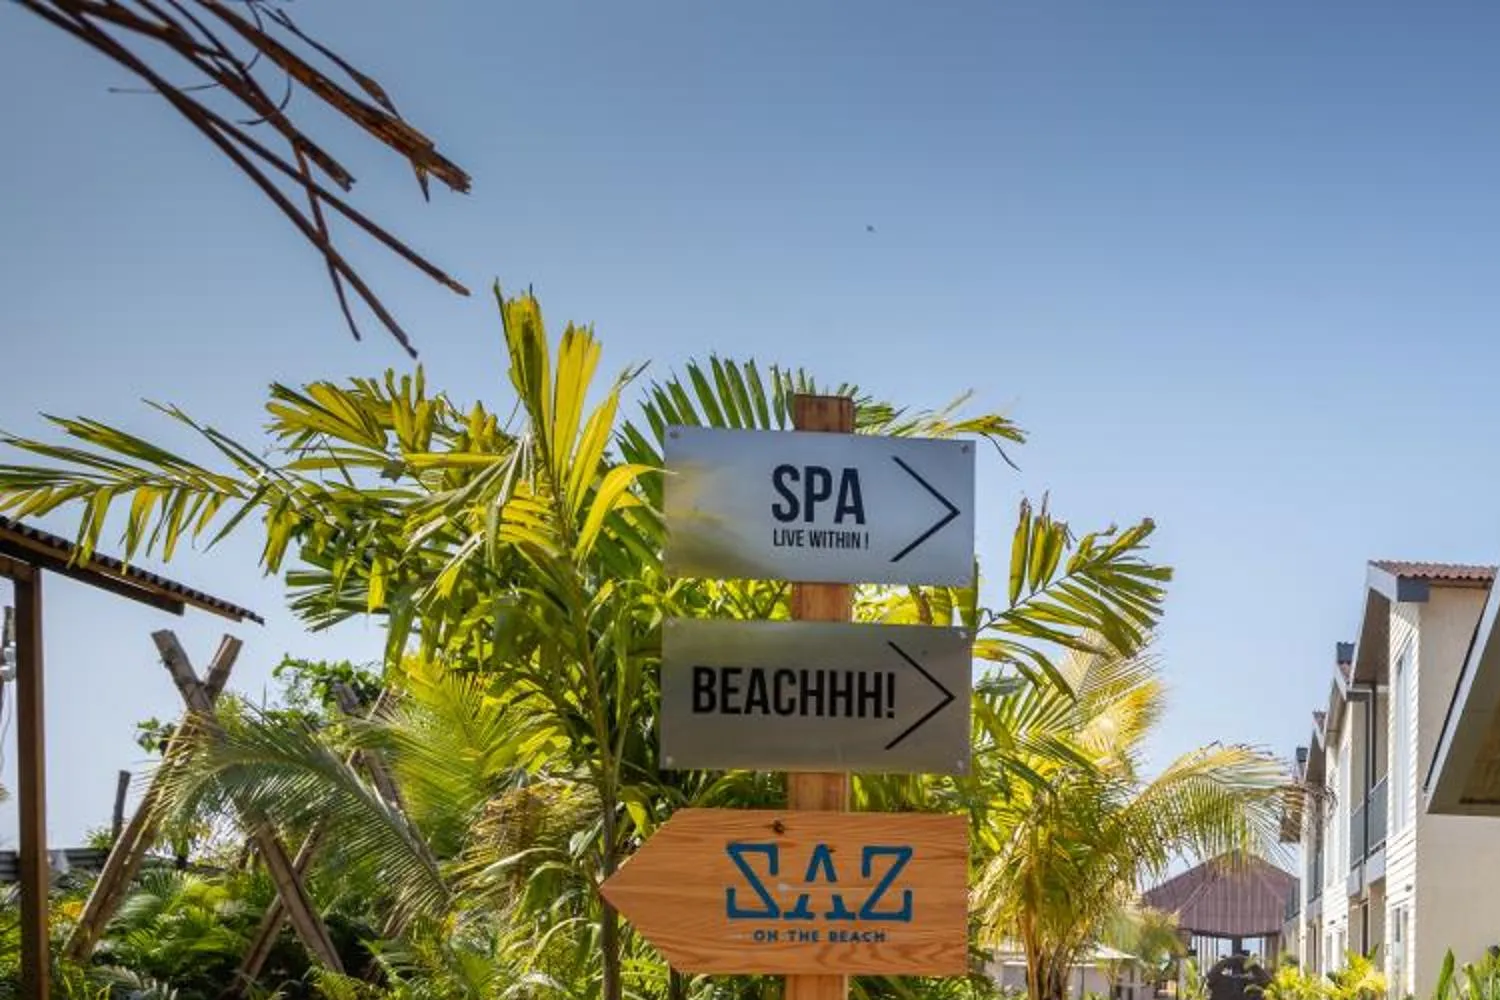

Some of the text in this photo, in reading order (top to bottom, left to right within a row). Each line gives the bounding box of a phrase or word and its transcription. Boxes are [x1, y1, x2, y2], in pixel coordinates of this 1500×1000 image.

[771, 463, 867, 525] SPA
[773, 528, 805, 547] LIVE
[692, 665, 896, 719] BEACHHH!
[753, 928, 886, 944] ON THE BEACH
